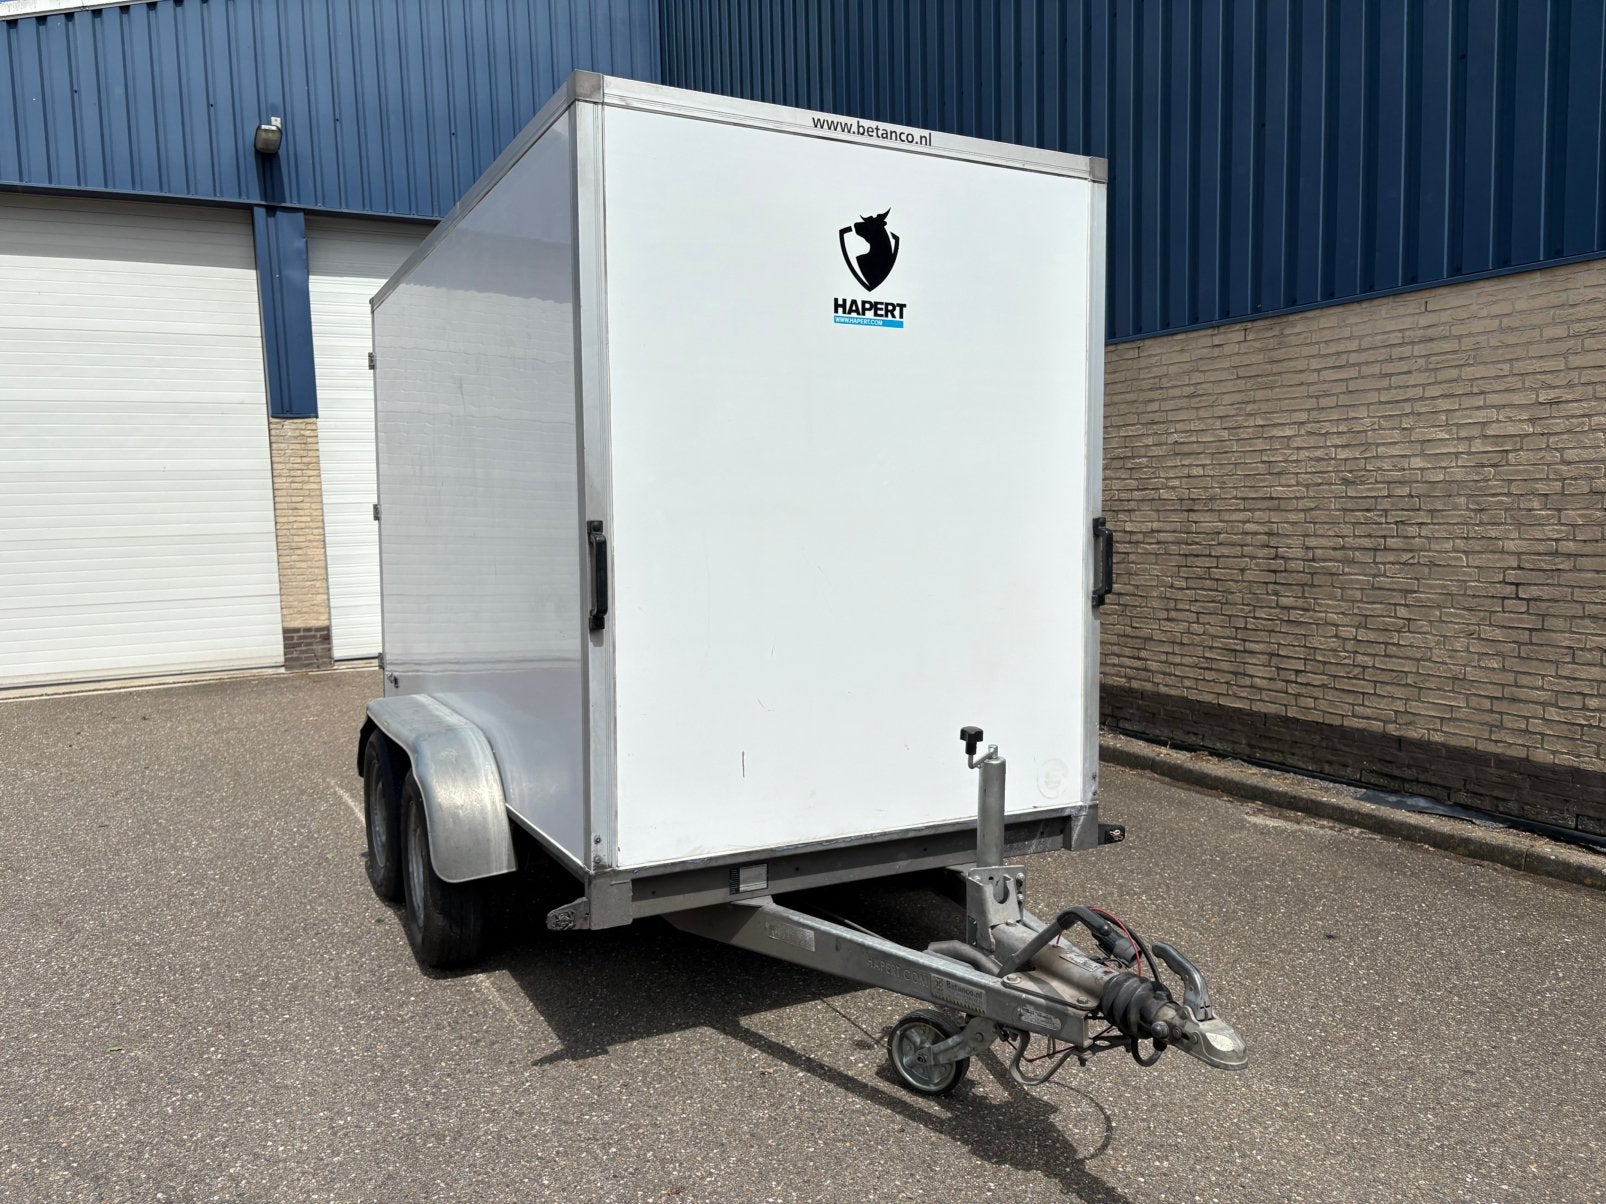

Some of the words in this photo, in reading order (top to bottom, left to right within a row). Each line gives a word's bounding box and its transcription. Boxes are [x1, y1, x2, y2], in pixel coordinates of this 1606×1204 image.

[812, 116, 932, 147] www.betanco.nl
[833, 297, 907, 319] HAPERT
[834, 316, 883, 326] WWW.HAPERT.COM
